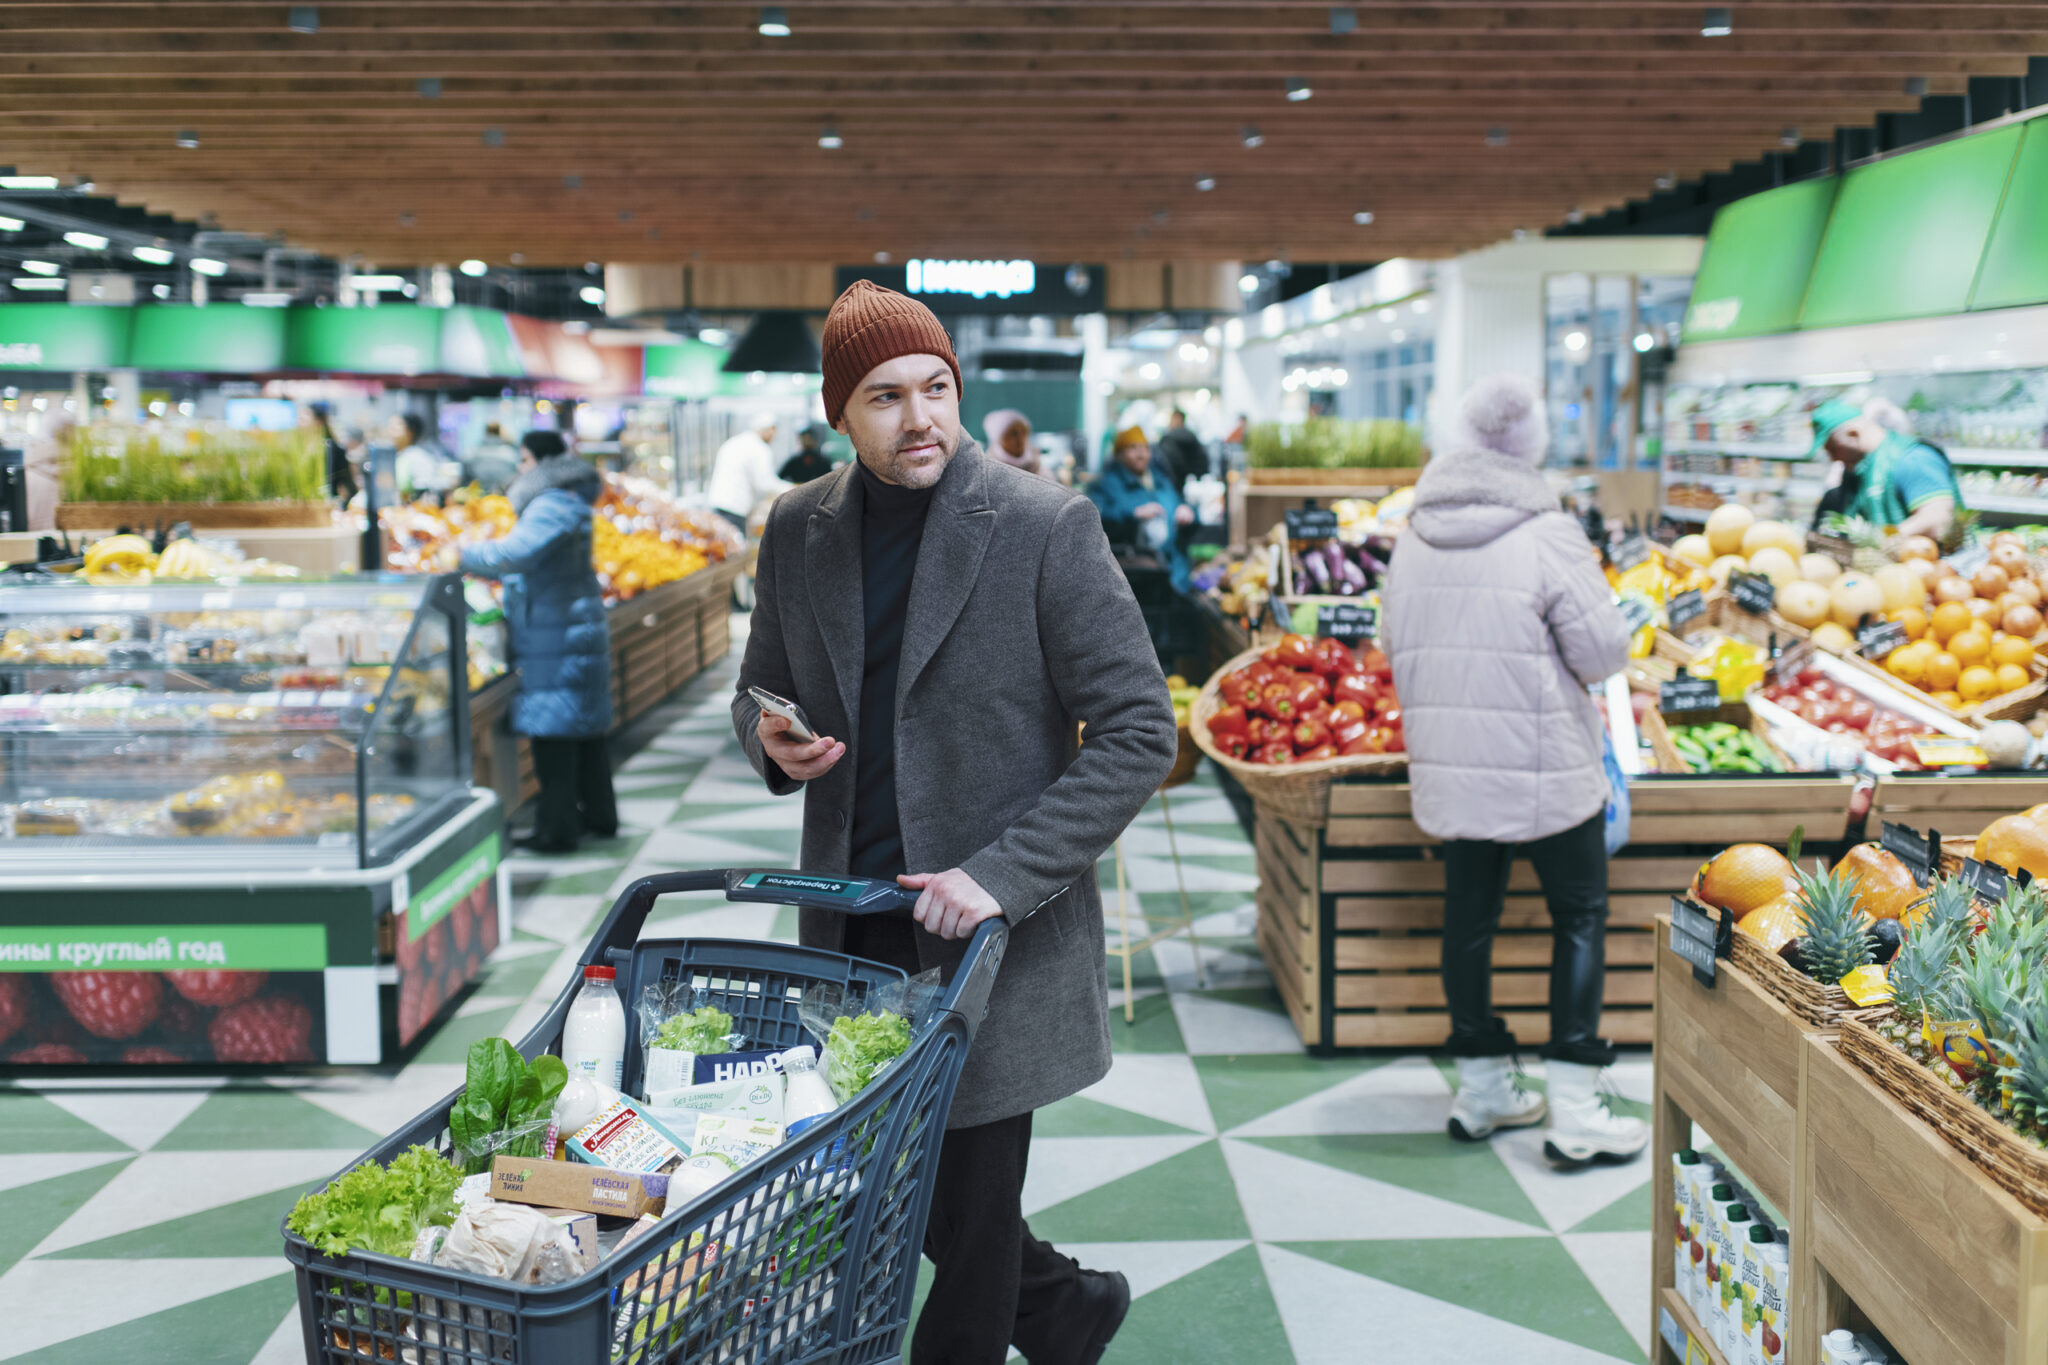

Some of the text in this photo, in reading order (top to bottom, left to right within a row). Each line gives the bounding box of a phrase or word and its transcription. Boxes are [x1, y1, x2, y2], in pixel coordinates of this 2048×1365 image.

[58, 937, 172, 966] круглый
[178, 941, 227, 965] год
[592, 1187, 628, 1203] ПАСТИЛА
